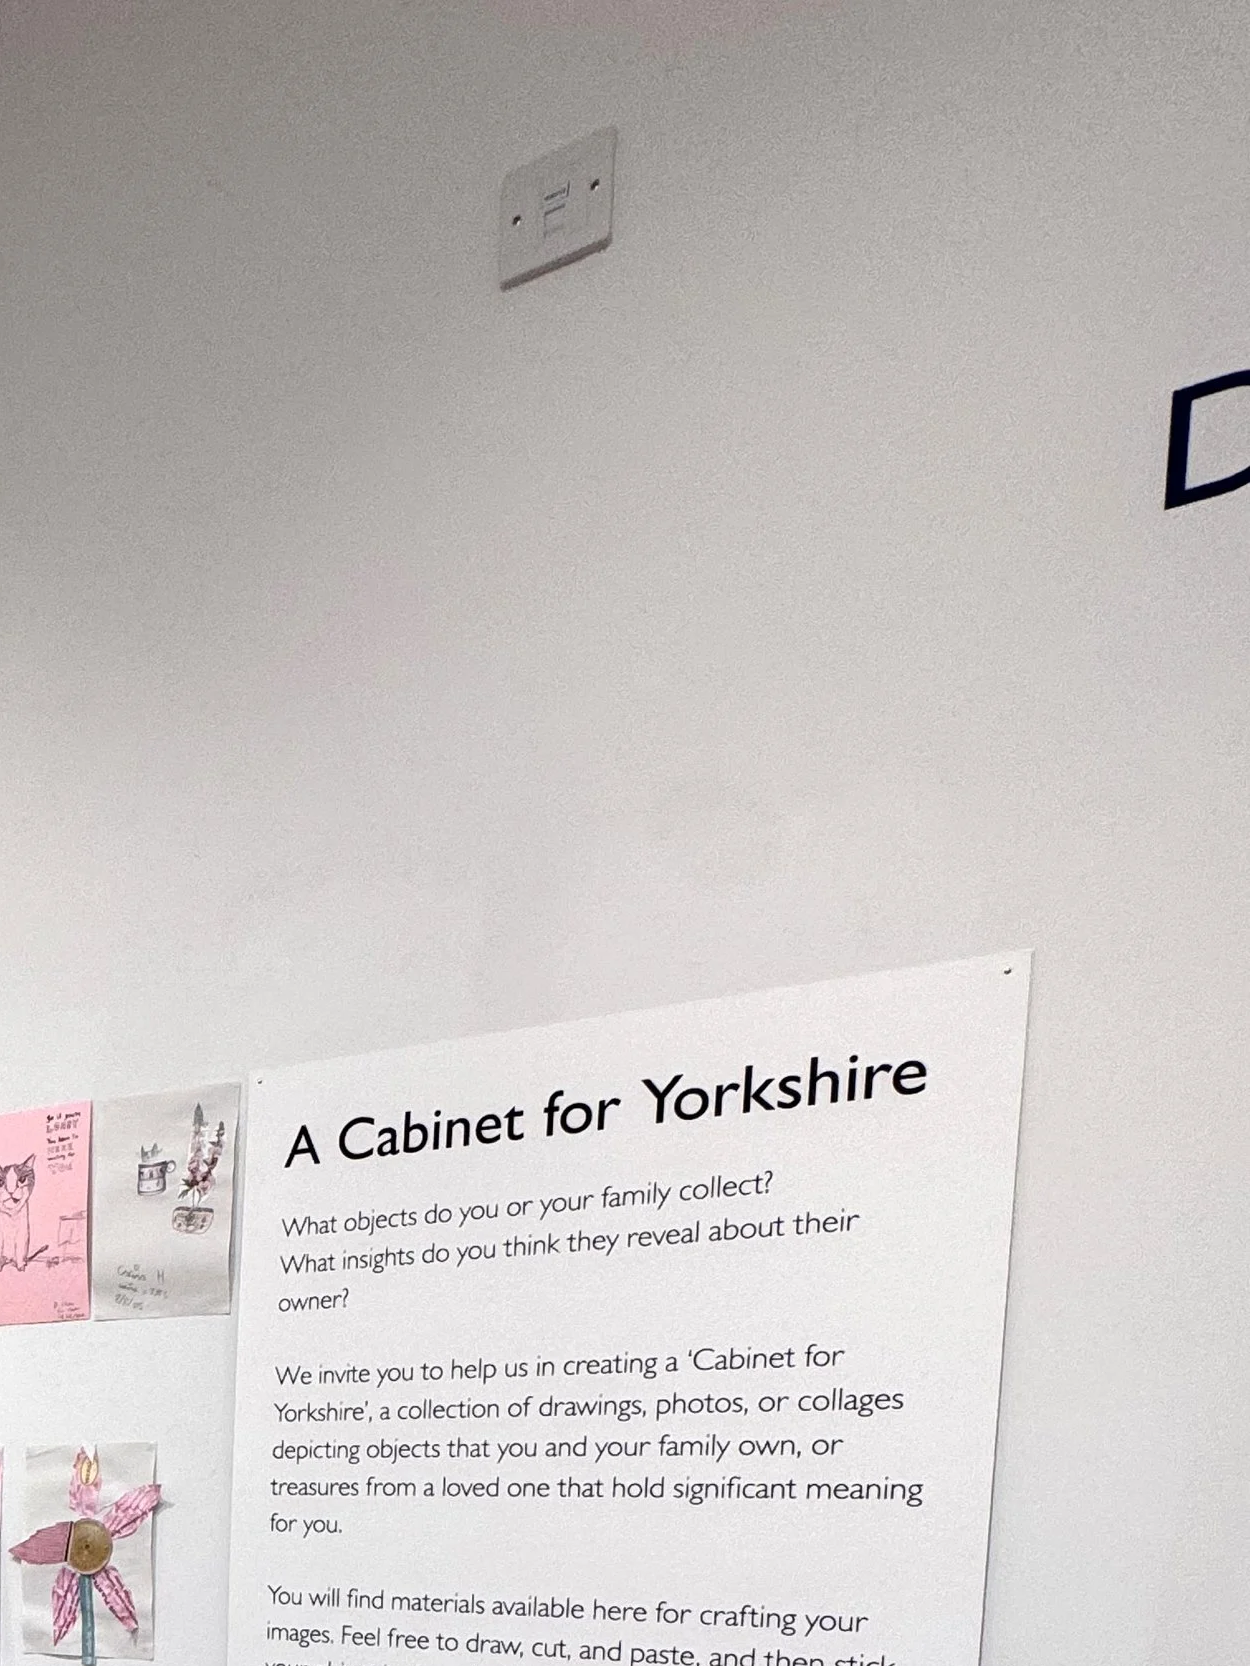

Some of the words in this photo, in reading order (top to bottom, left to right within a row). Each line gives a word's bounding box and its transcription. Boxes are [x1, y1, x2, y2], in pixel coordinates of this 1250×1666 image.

[284, 1126, 320, 1168] A
[339, 1107, 524, 1160] Cabinet
[543, 1091, 621, 1137] for
[641, 1055, 927, 1124] Yorkshire
[281, 1215, 338, 1238] What
[343, 1208, 418, 1237] objects
[423, 1202, 453, 1225] do
[458, 1203, 499, 1228] you
[506, 1199, 534, 1217] or
[539, 1193, 595, 1221] your
[600, 1181, 672, 1211] family
[679, 1169, 774, 1202] collect?
[279, 1253, 336, 1275] What
[342, 1246, 415, 1274] insights
[421, 1242, 450, 1264] do
[456, 1243, 496, 1268] you
[501, 1232, 561, 1258] think
[565, 1229, 620, 1257] they
[627, 1220, 701, 1248] reveal
[708, 1216, 786, 1242] about
[791, 1207, 861, 1236] their
[278, 1287, 350, 1313] owner?
[274, 1365, 313, 1386] We
[318, 1363, 371, 1385] invite
[376, 1366, 414, 1389] you
[419, 1362, 444, 1381] to
[450, 1357, 498, 1386] help
[504, 1361, 529, 1379] us
[536, 1354, 555, 1377] in
[562, 1351, 659, 1380] creating
[664, 1356, 679, 1373] a
[804, 1343, 846, 1368] for
[379, 1406, 392, 1421] a
[397, 1397, 500, 1421] collection
[507, 1395, 534, 1418] of
[538, 1393, 647, 1423] drawings,
[655, 1391, 749, 1422] photos,
[757, 1395, 790, 1413] or
[797, 1387, 905, 1418] collages
[271, 1439, 361, 1465] depicting
[366, 1437, 441, 1465] objects
[446, 1436, 491, 1459] that
[496, 1442, 538, 1465] you
[544, 1434, 588, 1458] and
[594, 1440, 652, 1464] your
[657, 1433, 731, 1464] family
[737, 1438, 802, 1459] own,
[811, 1438, 845, 1456] or
[269, 1478, 360, 1497] treasures
[365, 1475, 417, 1497] from
[422, 1481, 436, 1497] a
[441, 1476, 500, 1498] loved
[506, 1482, 551, 1498] one
[556, 1475, 605, 1499] that
[612, 1475, 665, 1499] hold
[672, 1475, 798, 1506] significant
[805, 1475, 924, 1508] meaning
[269, 1512, 298, 1533] for
[302, 1518, 343, 1539] you.
[266, 1584, 303, 1606] You
[308, 1586, 341, 1608] will
[346, 1587, 385, 1610] find
[391, 1592, 486, 1615] materials
[491, 1595, 585, 1620] available
[592, 1598, 648, 1623] here
[655, 1600, 693, 1625] for
[699, 1604, 798, 1637] crafting
[803, 1614, 870, 1638] your
[266, 1620, 334, 1649] images.
[341, 1624, 381, 1647] Feel
[386, 1627, 430, 1651] free
[435, 1632, 459, 1652] to
[465, 1632, 524, 1659] draw,
[531, 1639, 572, 1662] cut,
[578, 1639, 622, 1662] and
